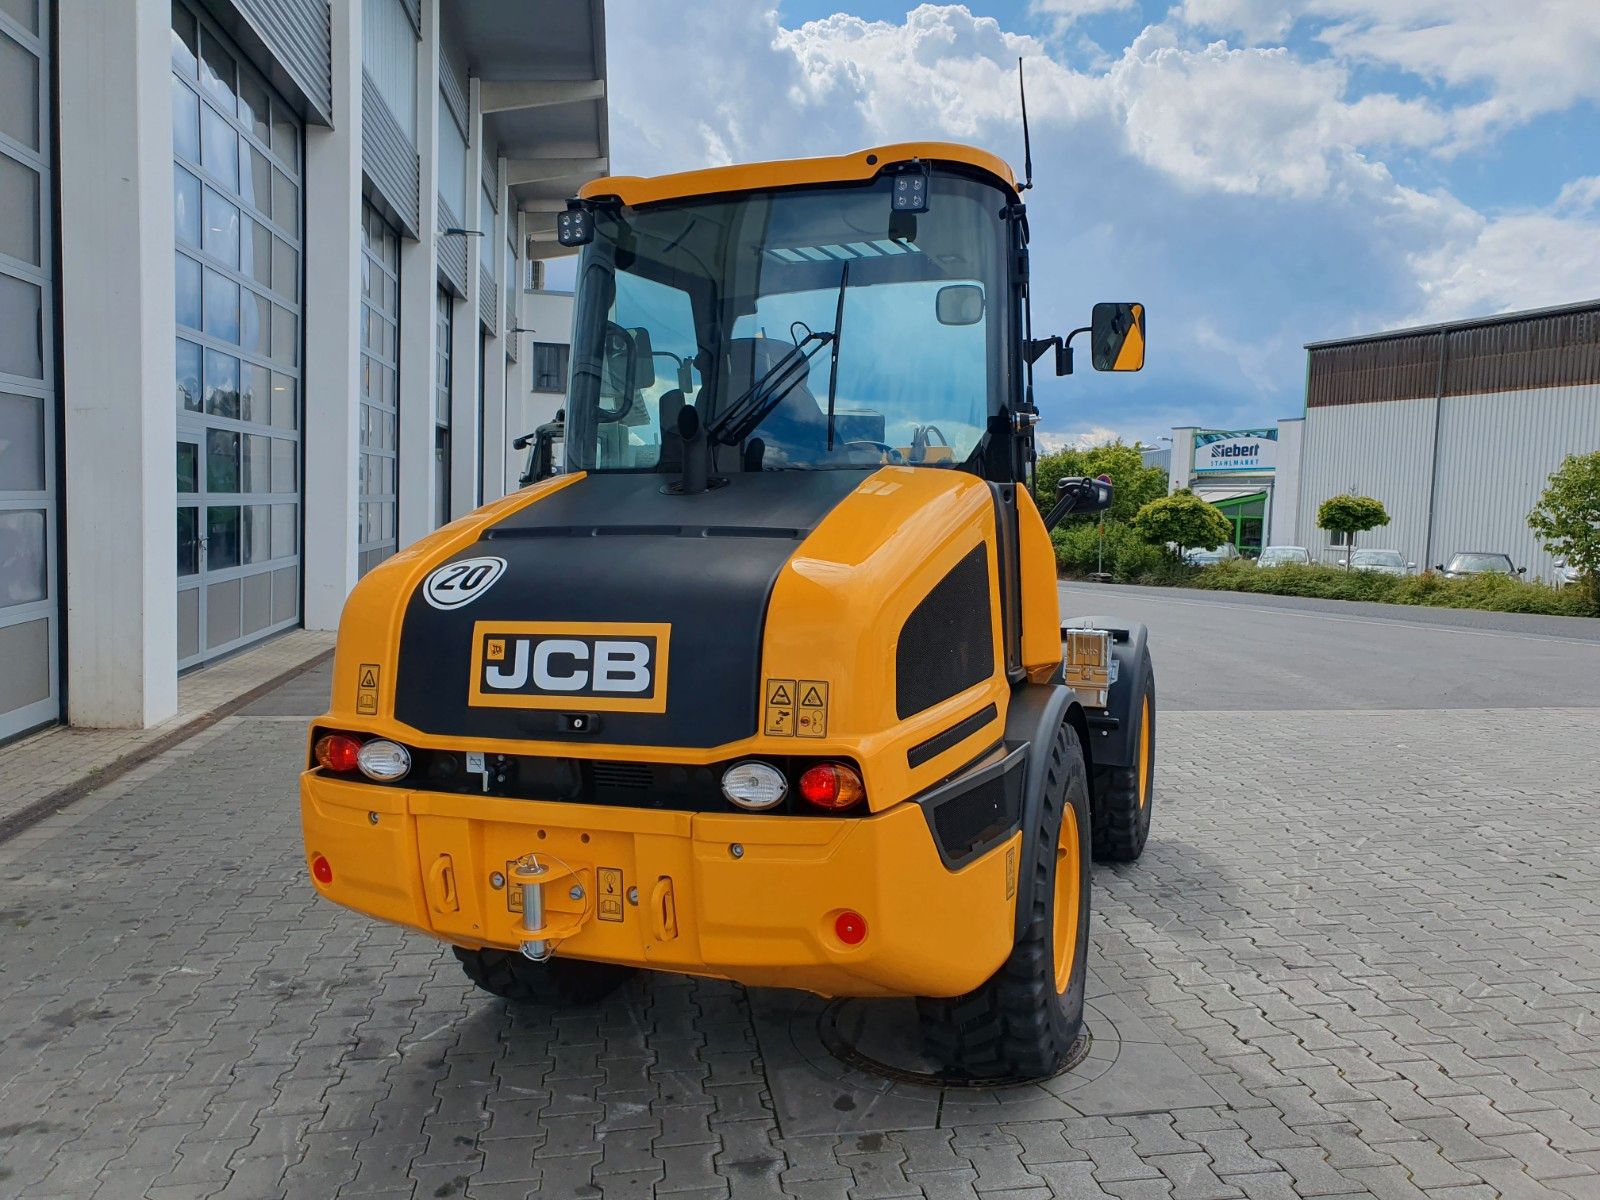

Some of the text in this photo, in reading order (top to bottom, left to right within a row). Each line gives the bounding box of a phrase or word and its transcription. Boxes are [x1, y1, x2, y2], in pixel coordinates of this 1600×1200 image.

[1211, 443, 1260, 458] Siebert
[1211, 459, 1259, 467] STAHLMARKT
[434, 565, 494, 591] 20
[485, 639, 650, 692] JCB
